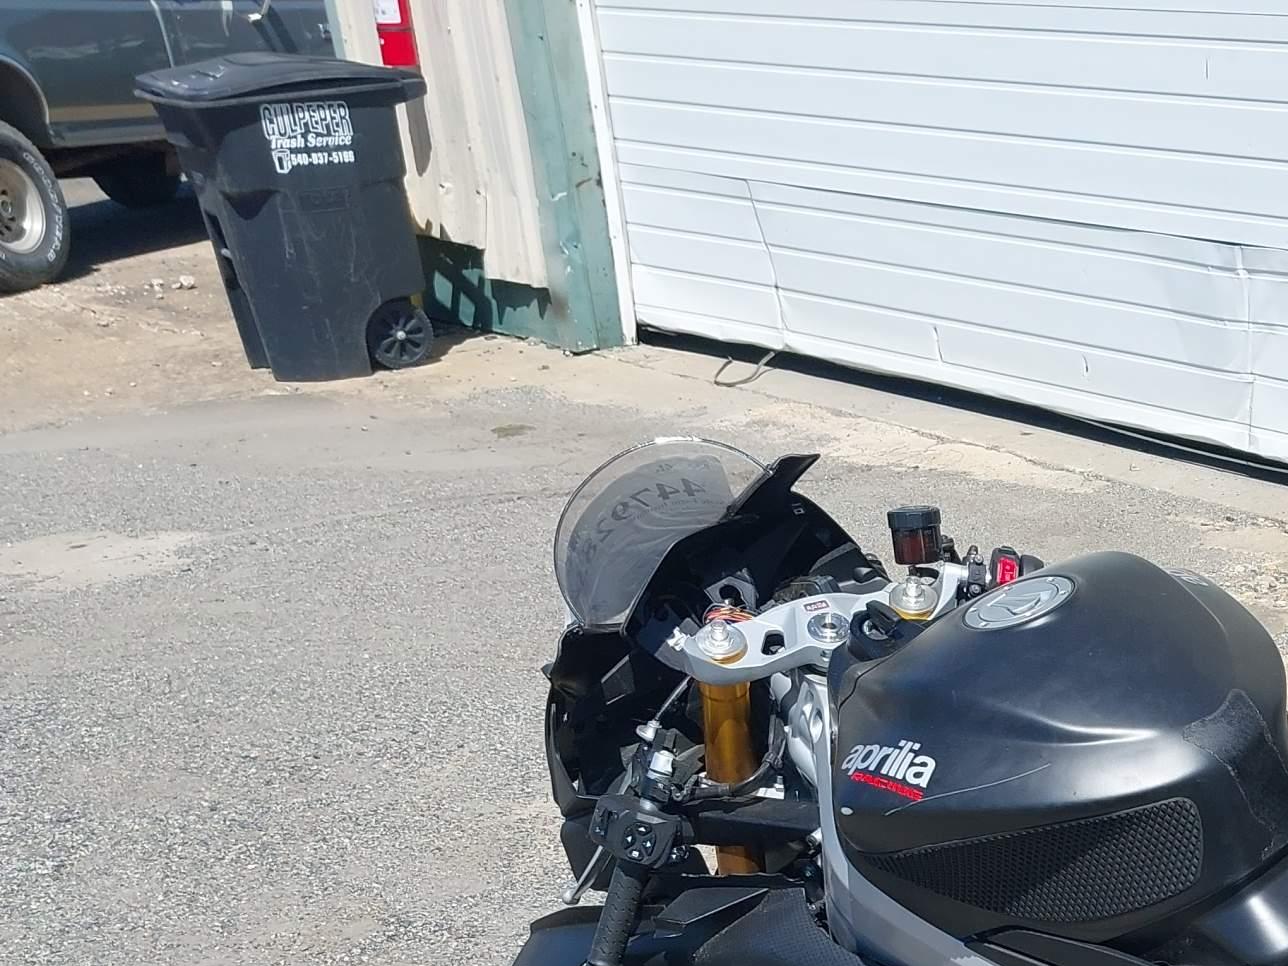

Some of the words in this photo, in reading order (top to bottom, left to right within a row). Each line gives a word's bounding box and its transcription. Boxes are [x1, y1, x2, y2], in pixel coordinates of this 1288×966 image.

[260, 100, 354, 140] CULPEPER
[270, 134, 305, 150] Trash
[306, 132, 352, 148] Service
[841, 739, 937, 789] aprilia
